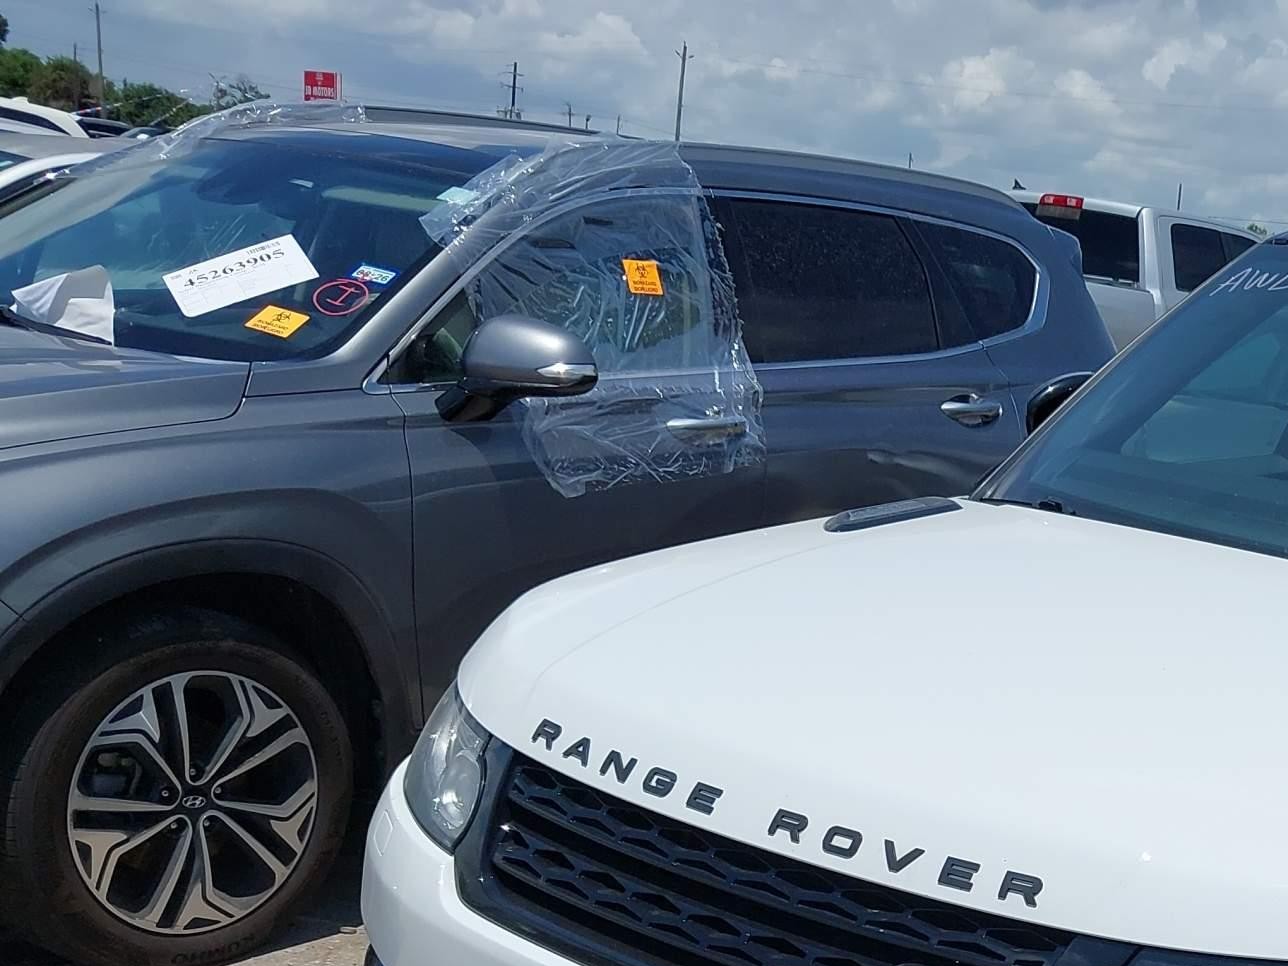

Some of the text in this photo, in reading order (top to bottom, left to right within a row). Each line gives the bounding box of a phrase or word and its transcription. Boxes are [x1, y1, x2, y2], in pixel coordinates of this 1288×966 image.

[183, 249, 285, 287] 45263905
[531, 718, 1044, 908] RANGE ROVER
